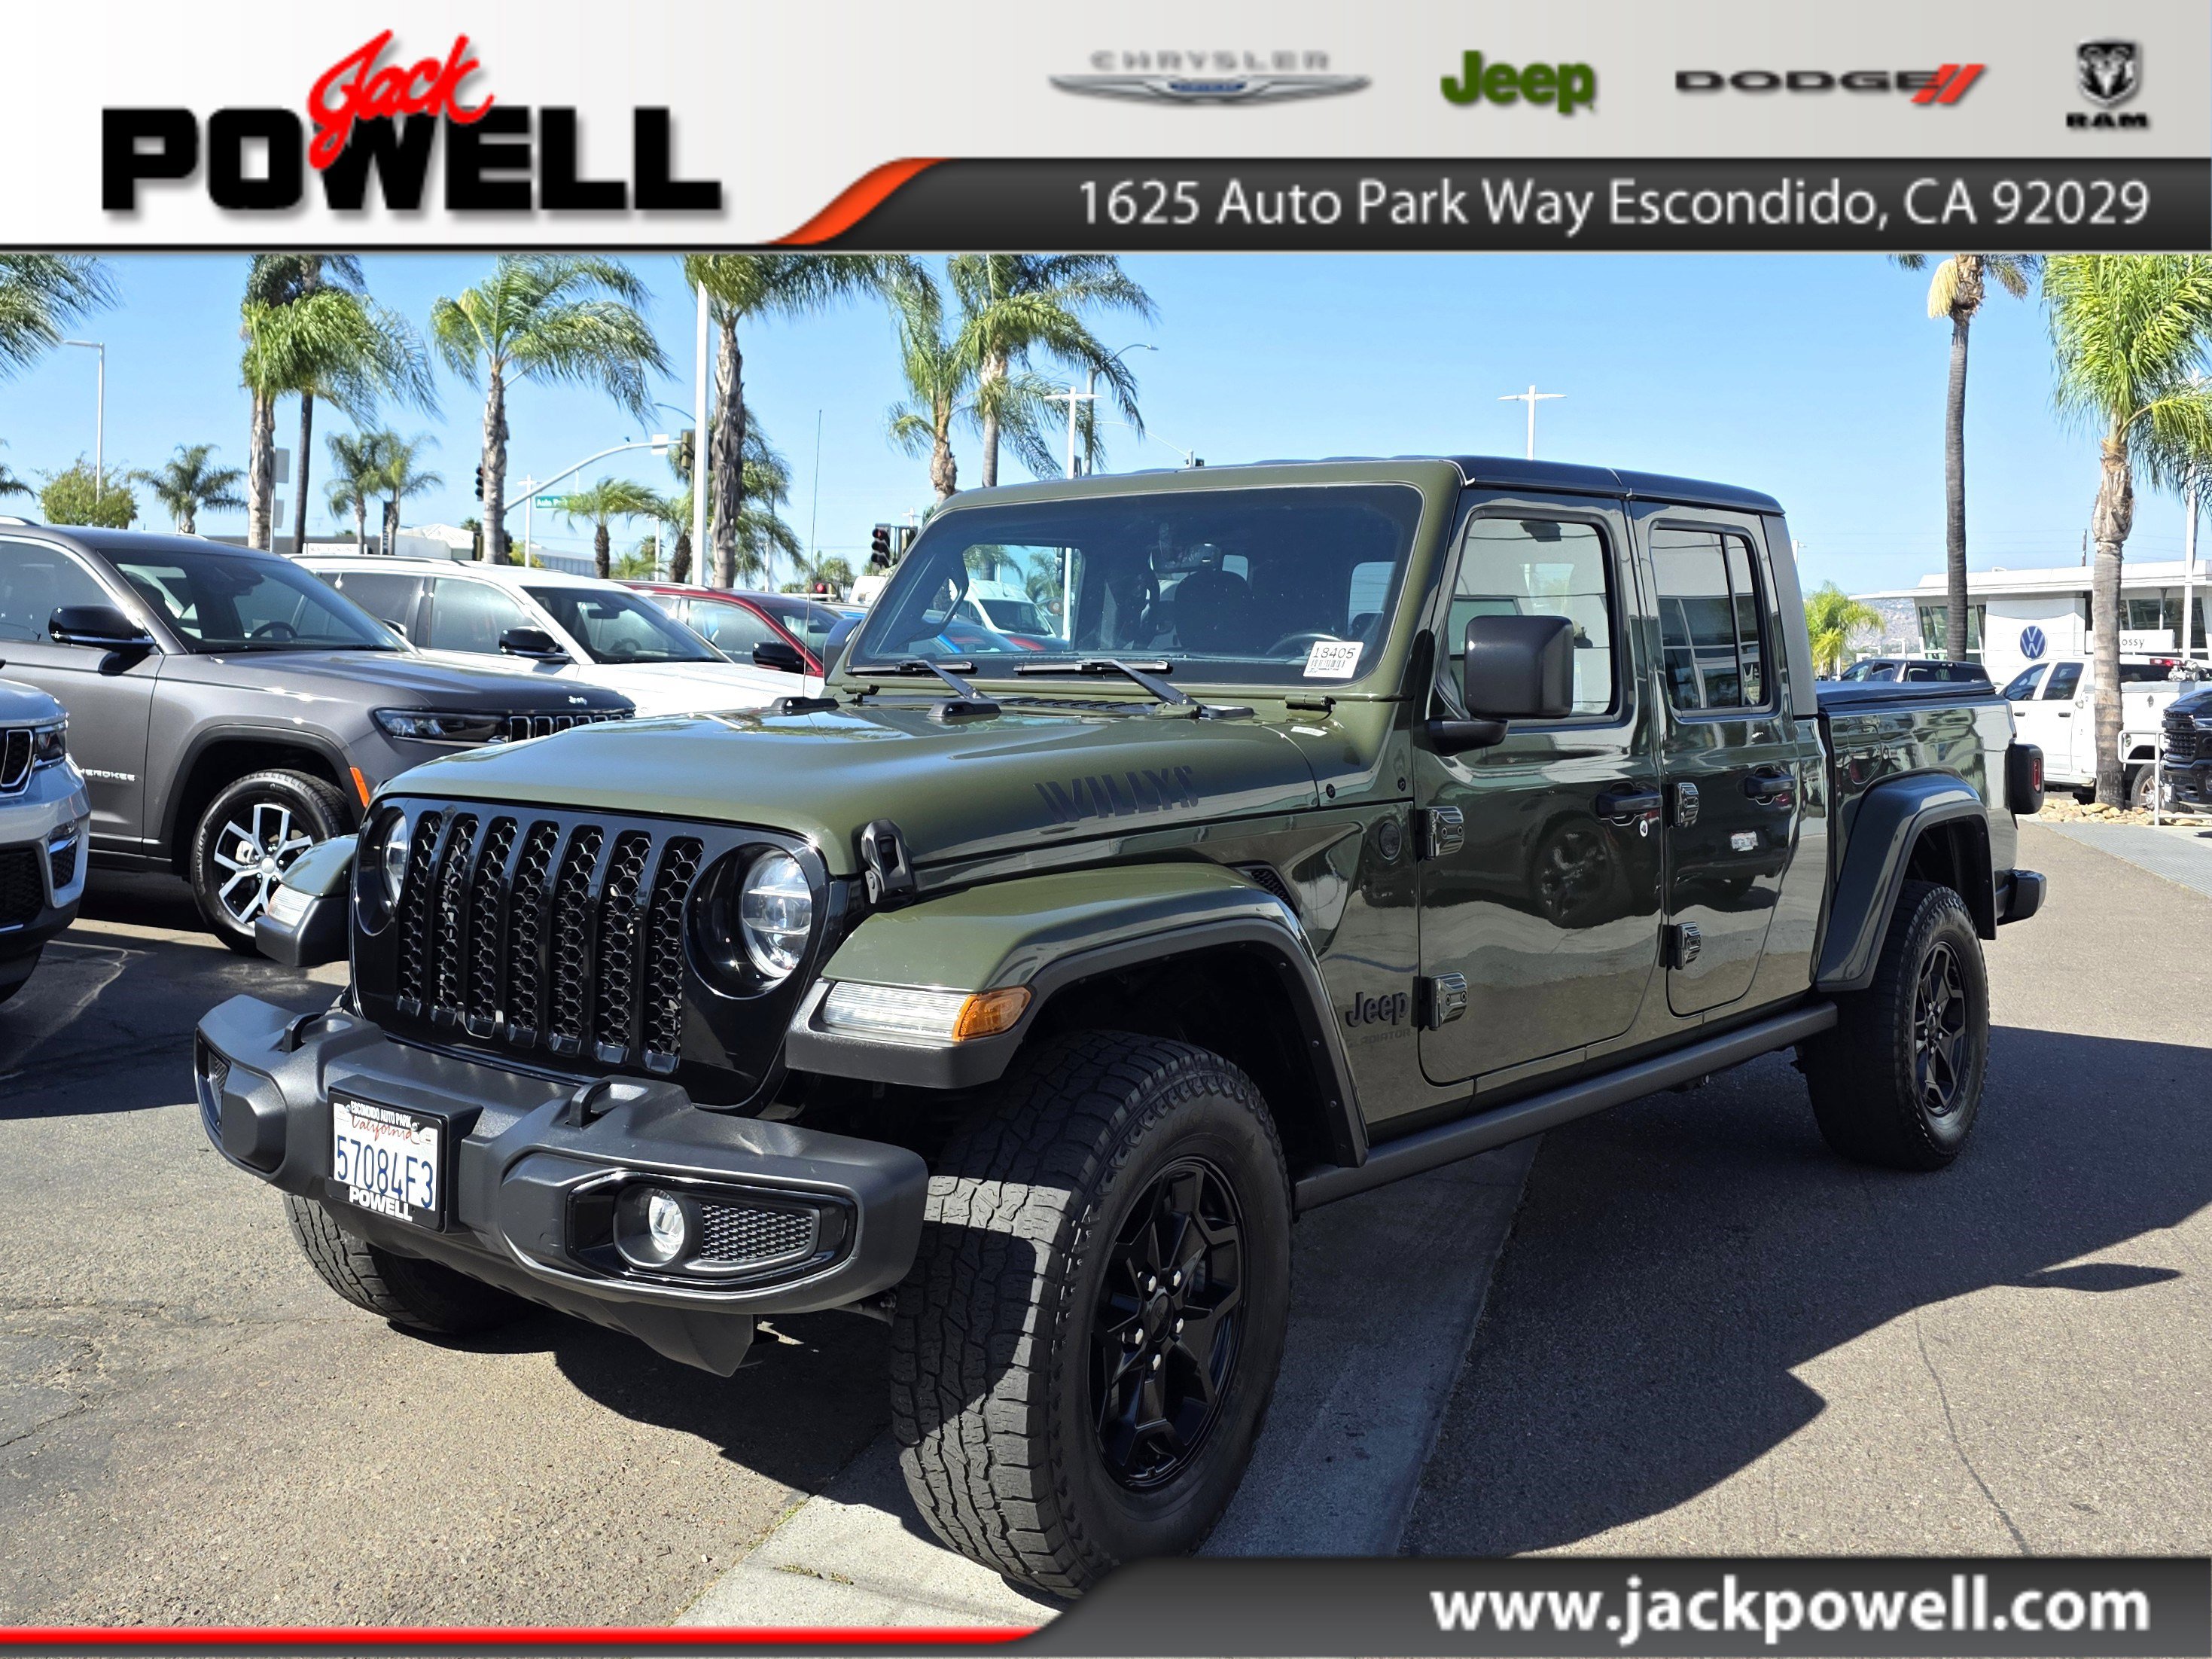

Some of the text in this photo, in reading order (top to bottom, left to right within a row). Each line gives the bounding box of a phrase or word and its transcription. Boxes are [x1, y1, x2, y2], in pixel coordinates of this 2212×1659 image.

[1312, 647, 1356, 659] 18405
[2121, 637, 2145, 649] ossy
[1033, 765, 1199, 823] WILLYS
[1345, 991, 1409, 1028] Jeep
[350, 1100, 412, 1128] ESCONDIDO AUTO PARK
[352, 1115, 420, 1145] California
[337, 1134, 434, 1209] 57084F3
[349, 1185, 413, 1221] POWELL
